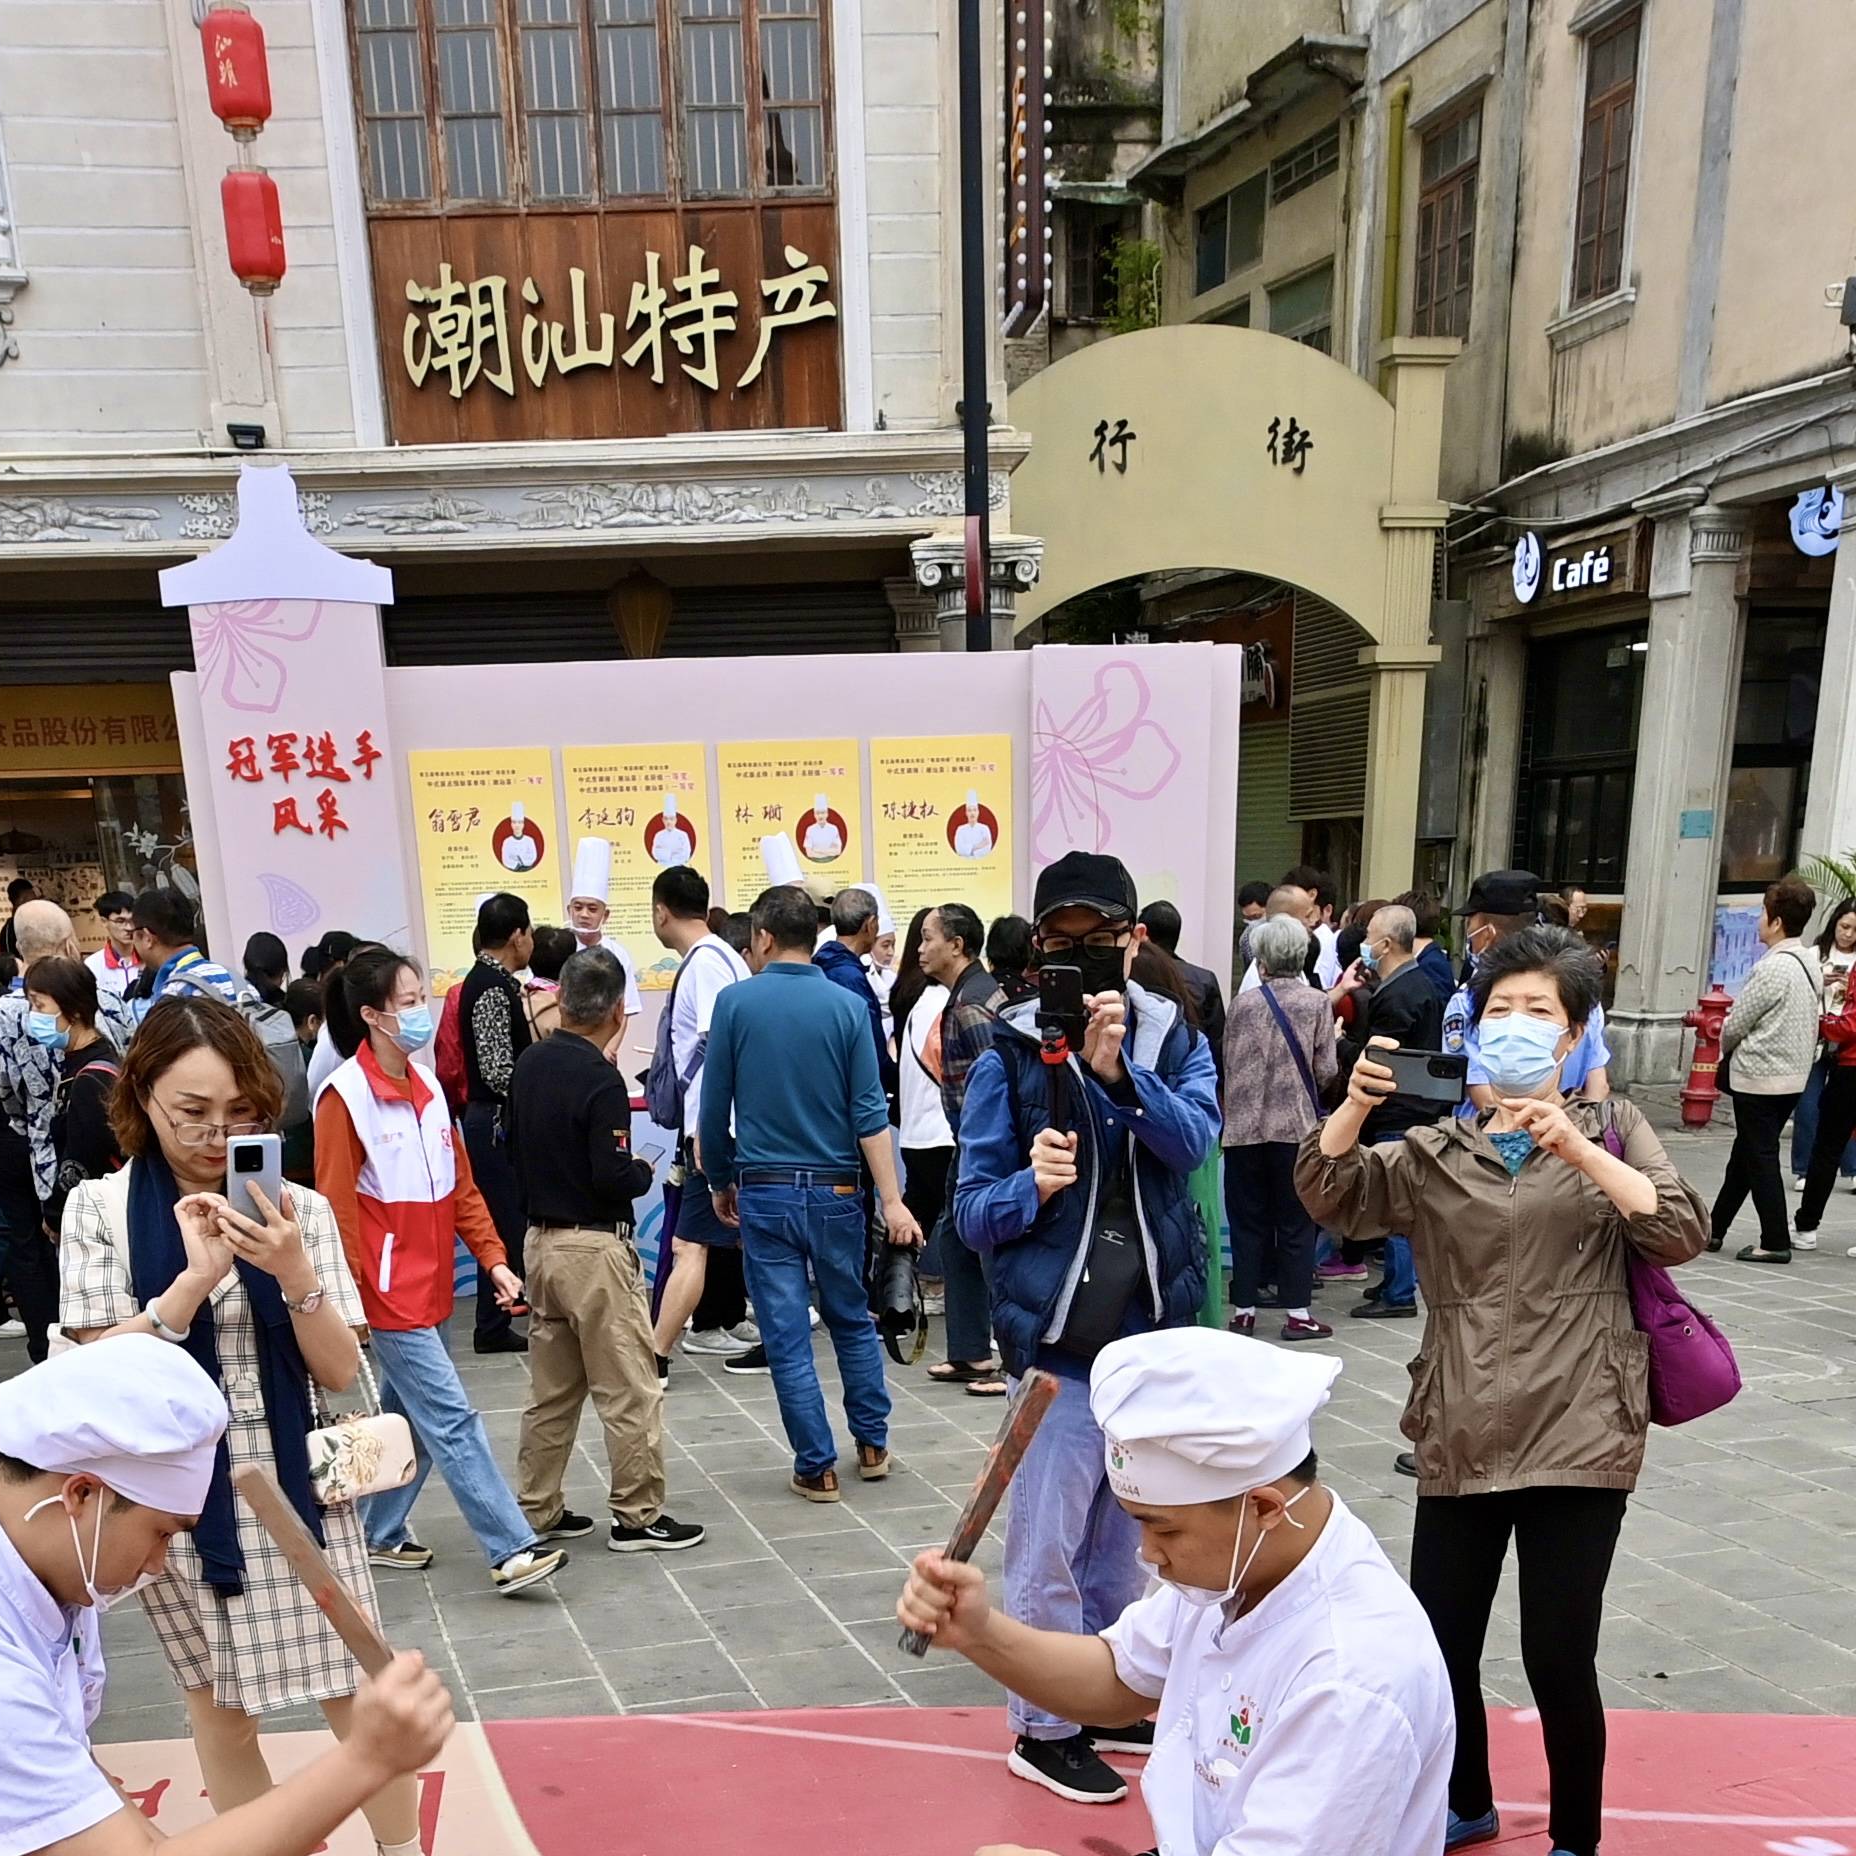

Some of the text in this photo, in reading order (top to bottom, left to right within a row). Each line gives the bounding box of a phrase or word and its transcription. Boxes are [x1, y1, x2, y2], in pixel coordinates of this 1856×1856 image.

[402, 243, 837, 399] 潮汕特产
[1552, 545, 1611, 591] Café
[225, 729, 383, 784] 冠军选手
[273, 787, 350, 841] 风采
